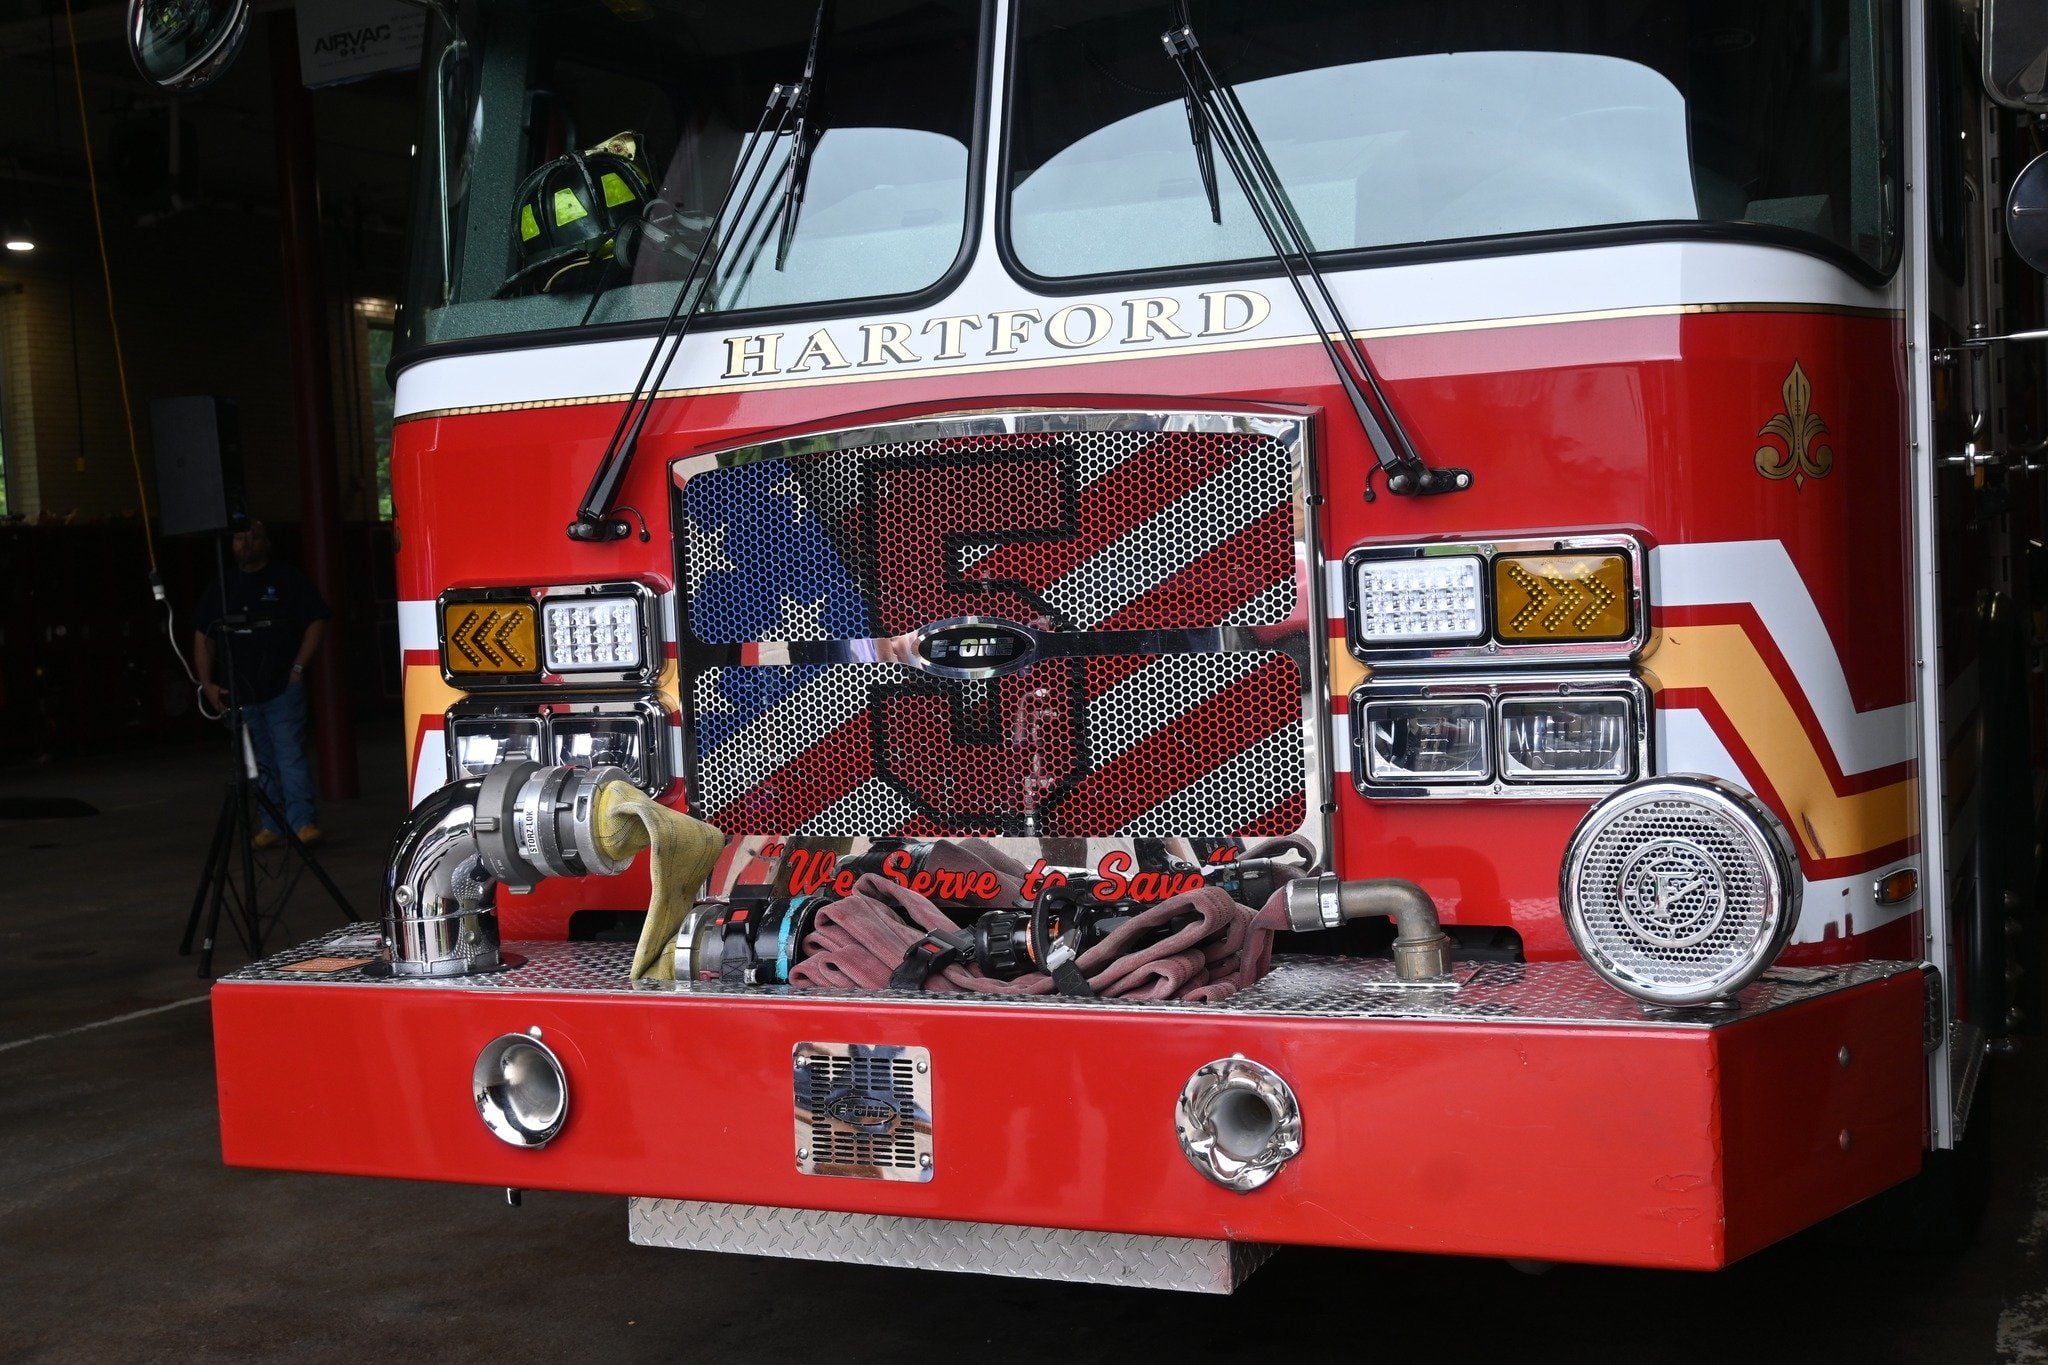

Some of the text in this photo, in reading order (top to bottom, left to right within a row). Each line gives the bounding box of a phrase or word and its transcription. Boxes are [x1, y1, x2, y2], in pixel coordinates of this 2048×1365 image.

[314, 24, 391, 55] AIRVAC
[340, 45, 366, 57] 911
[720, 290, 1269, 379] HARTFORD
[930, 637, 1014, 659] E-ONE
[526, 811, 537, 852] STORZ-LOK
[882, 850, 1002, 900] Serve
[835, 1104, 891, 1118] E-ONE
